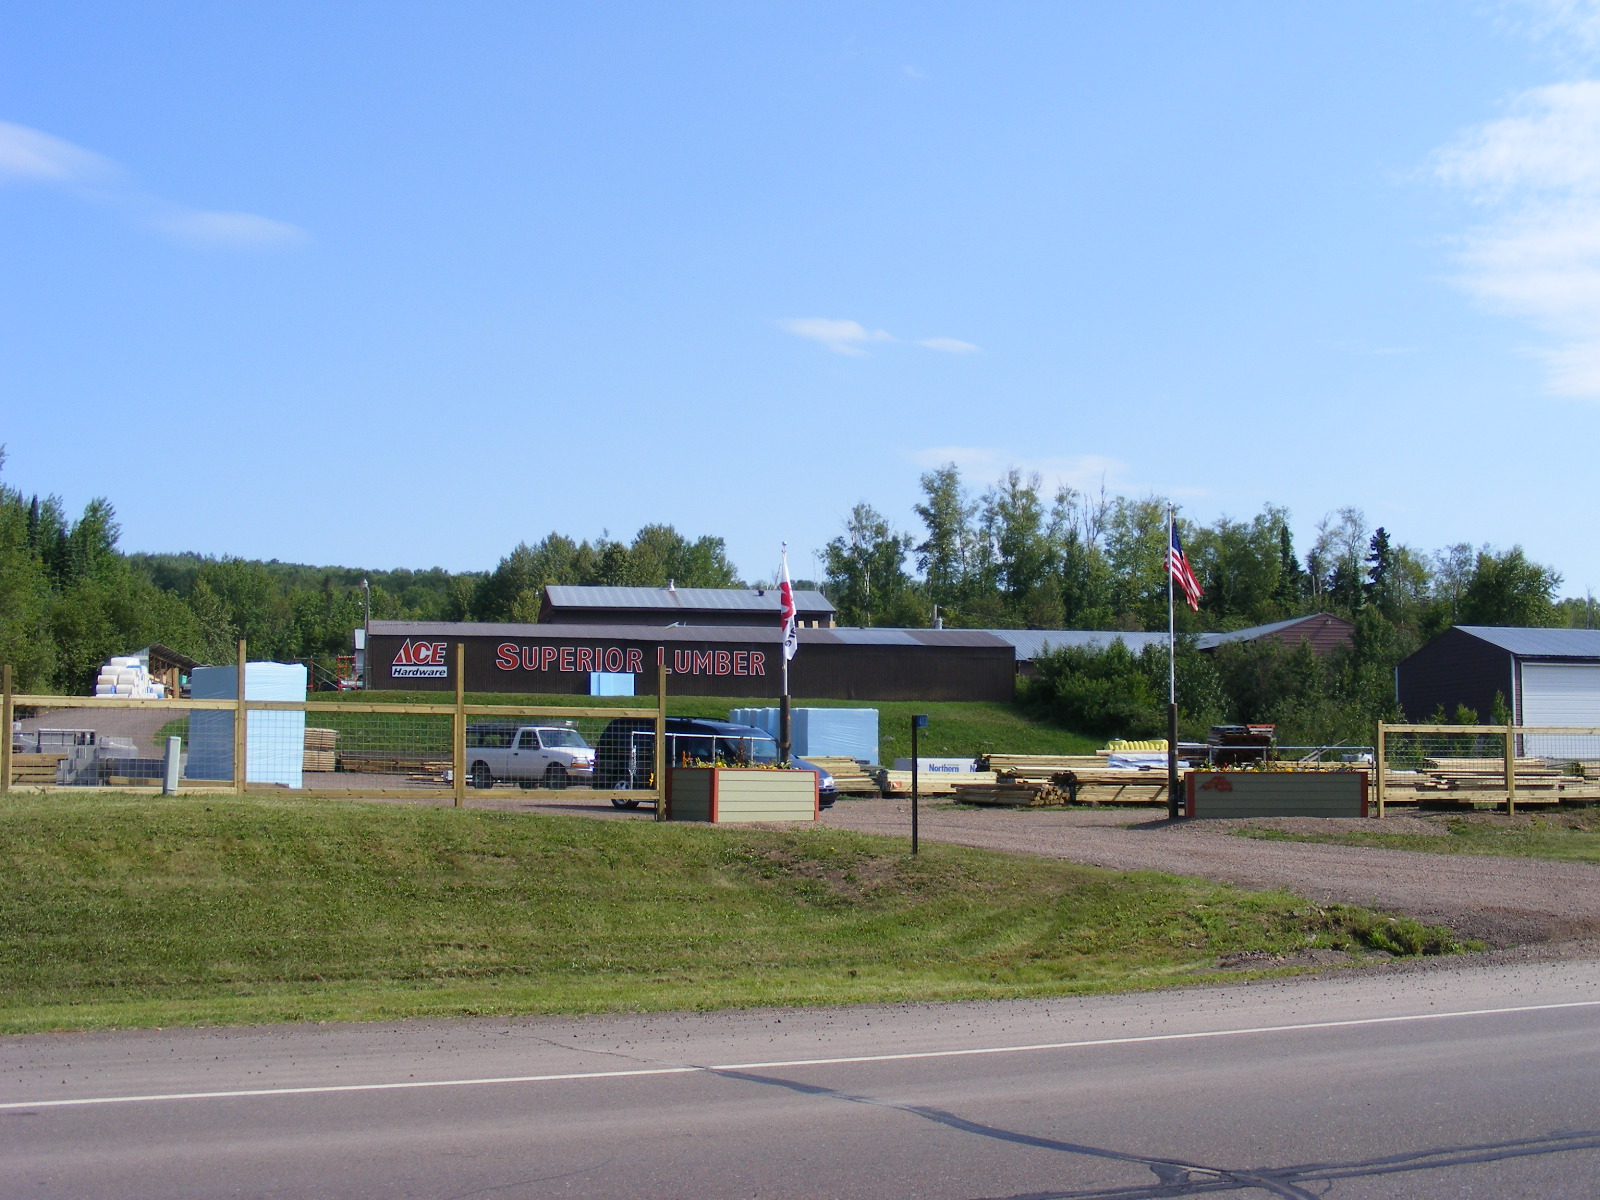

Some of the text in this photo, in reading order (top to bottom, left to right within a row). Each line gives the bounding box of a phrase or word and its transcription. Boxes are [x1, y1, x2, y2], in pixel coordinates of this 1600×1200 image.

[392, 638, 447, 664] ACE
[496, 642, 643, 673] SUPERIOR
[393, 667, 446, 676] Hardware
[928, 763, 960, 773] Northern
